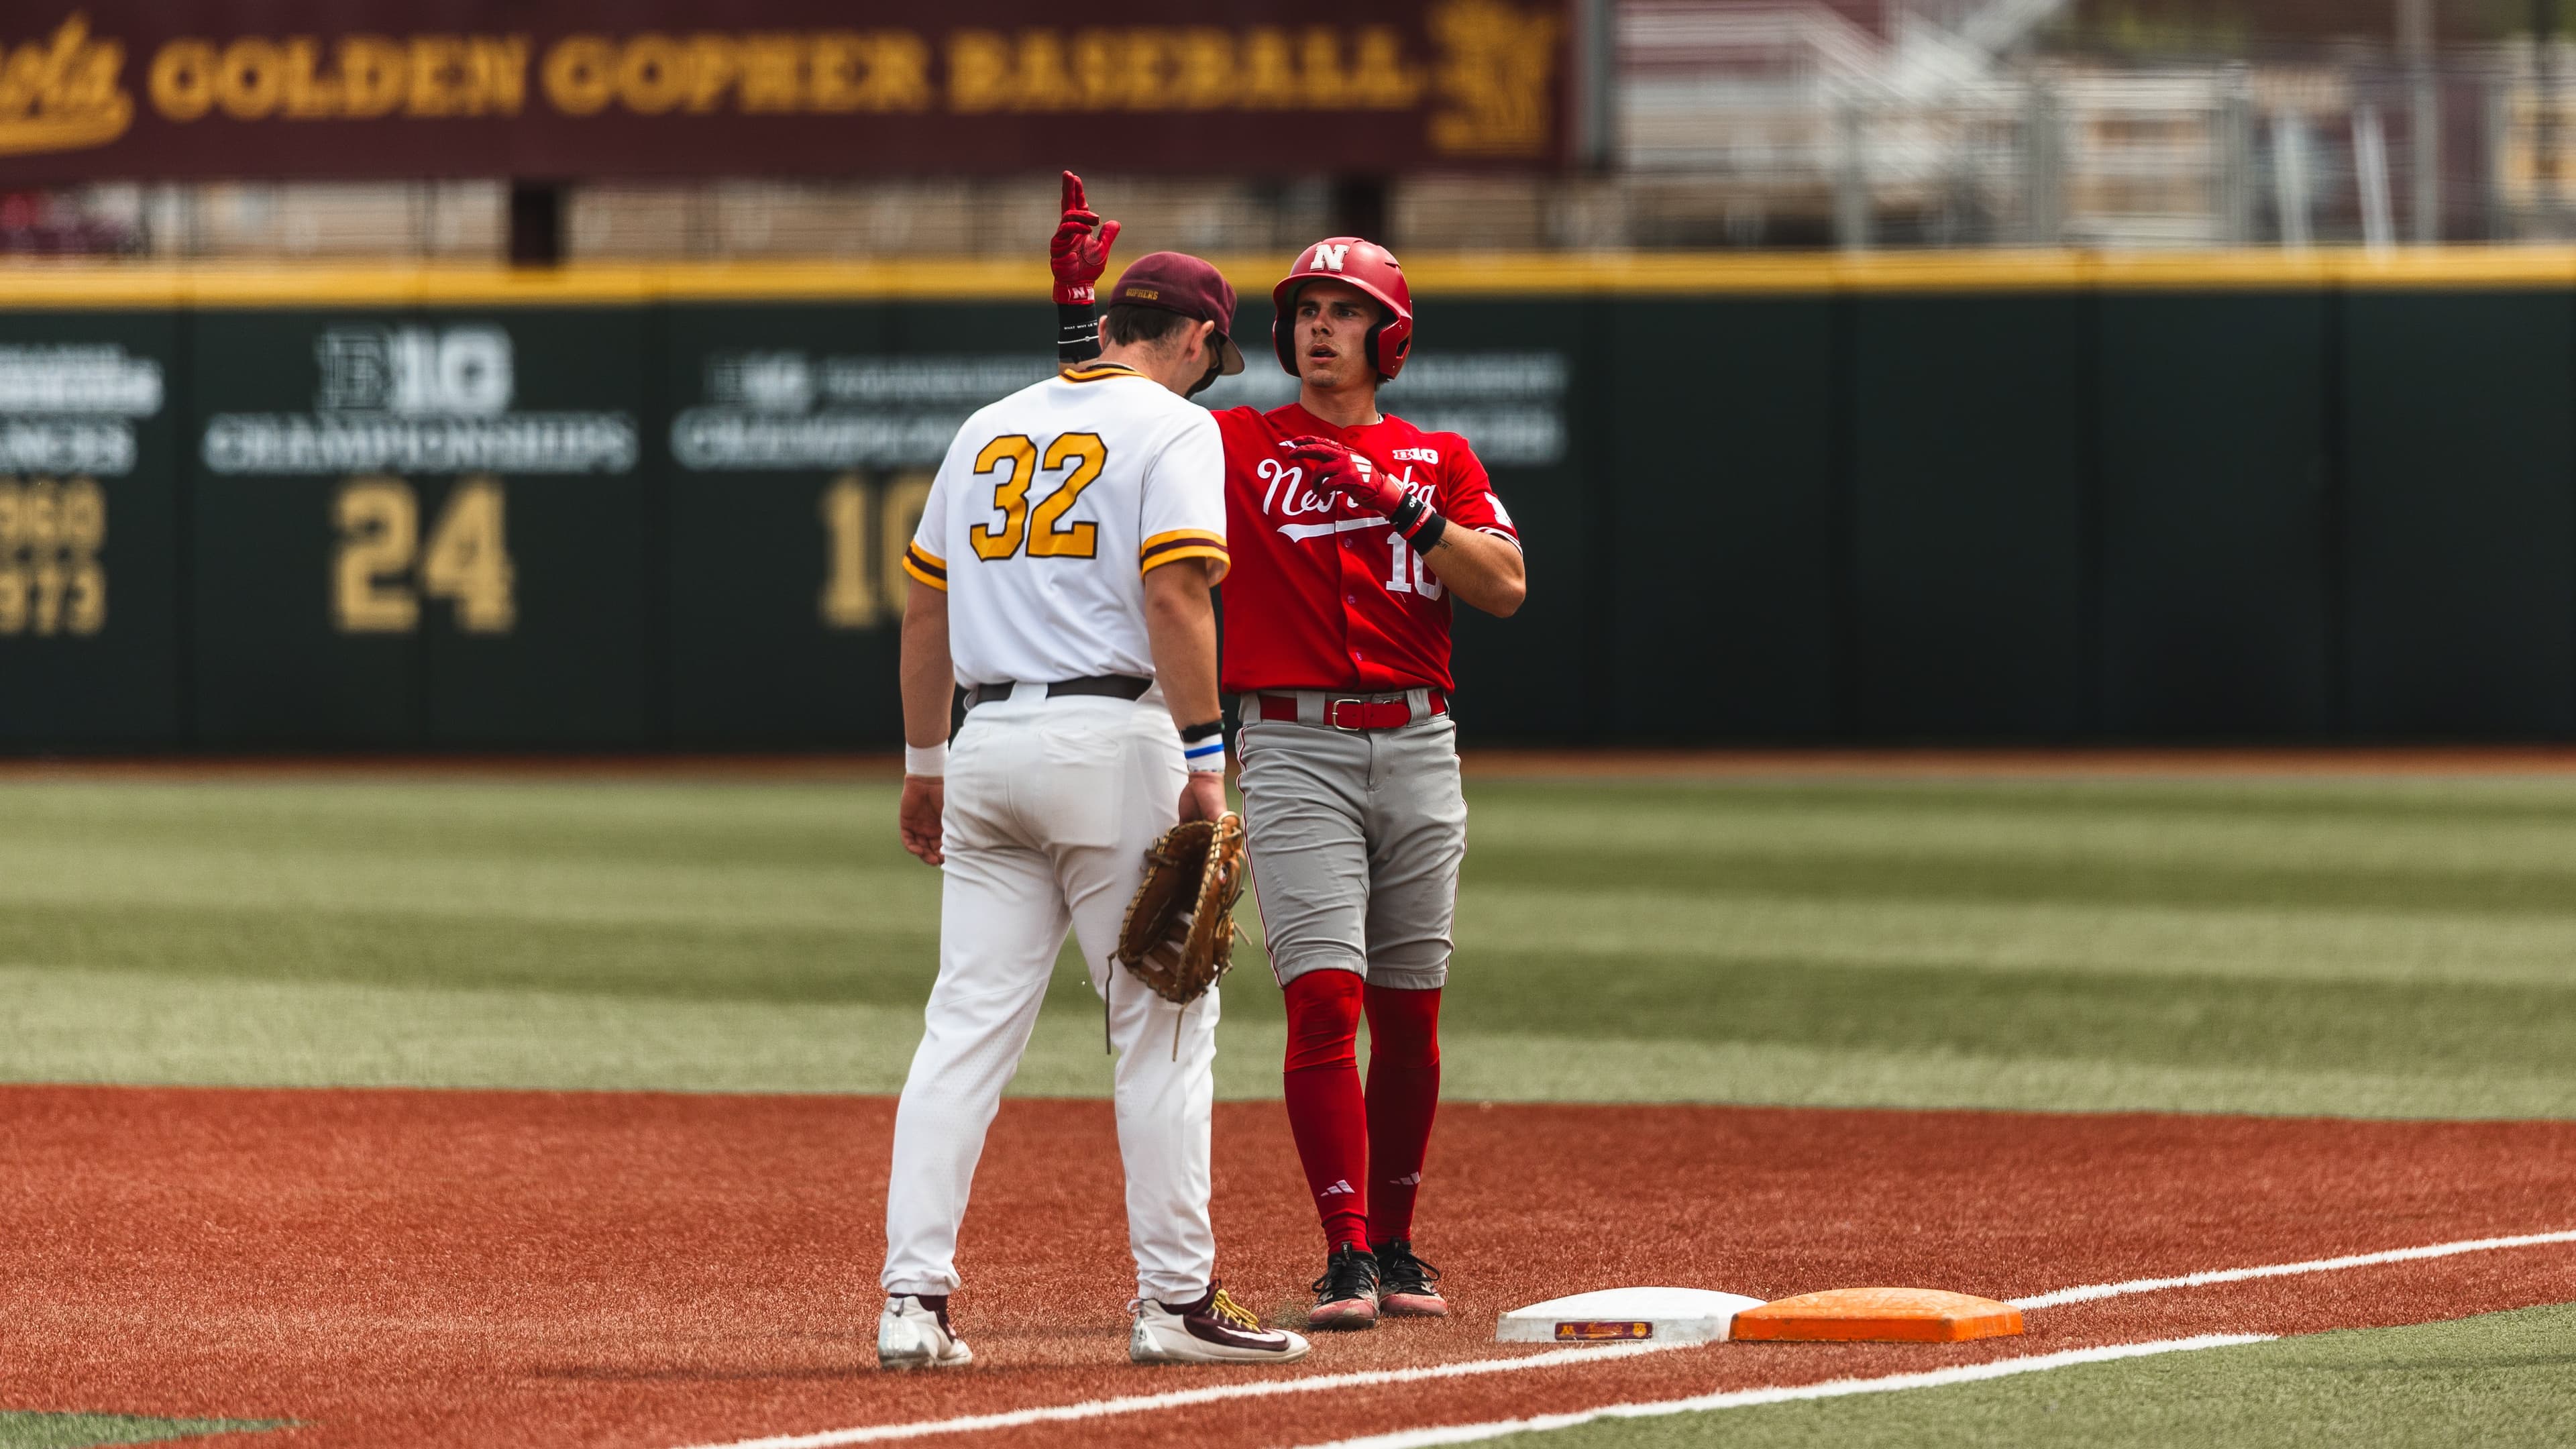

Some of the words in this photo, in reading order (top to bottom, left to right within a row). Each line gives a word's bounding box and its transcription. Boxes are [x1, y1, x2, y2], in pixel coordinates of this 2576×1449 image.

[149, 36, 527, 121] GOLDEN
[542, 31, 930, 115] GOPHER
[947, 25, 1422, 113] BASEBALL
[1126, 288, 1159, 300] GOPHERS
[1309, 244, 1350, 272] N
[205, 413, 637, 473] CHAMPIONSHIPS
[970, 432, 1109, 562] 32
[331, 479, 515, 632] 24
